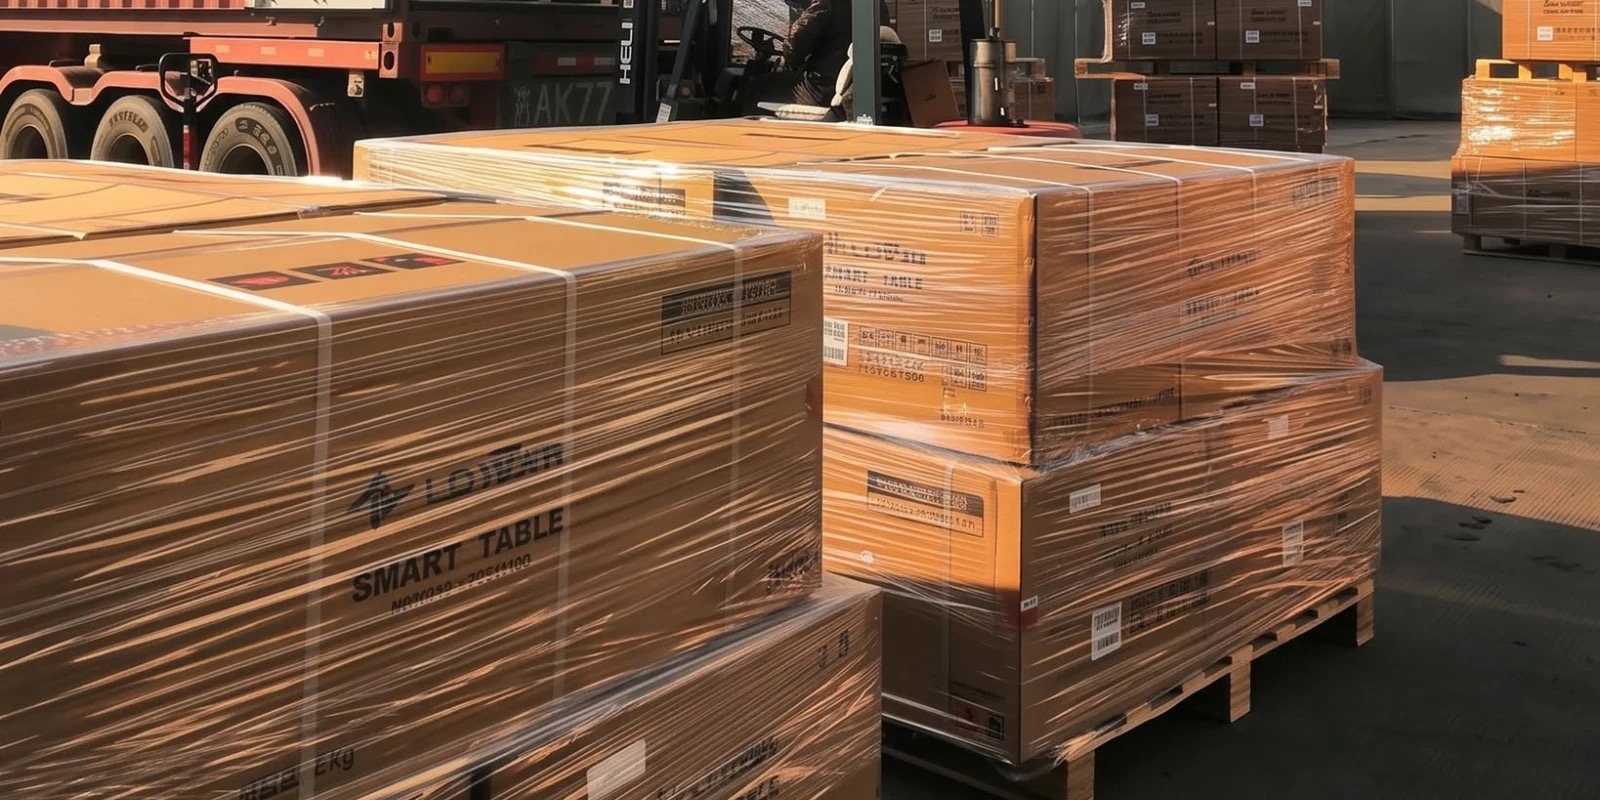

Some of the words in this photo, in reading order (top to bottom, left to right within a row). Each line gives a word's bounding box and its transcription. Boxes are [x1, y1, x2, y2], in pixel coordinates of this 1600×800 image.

[619, 22, 634, 85] HELI
[351, 542, 463, 602] SMART
[478, 507, 564, 559] TABLE
